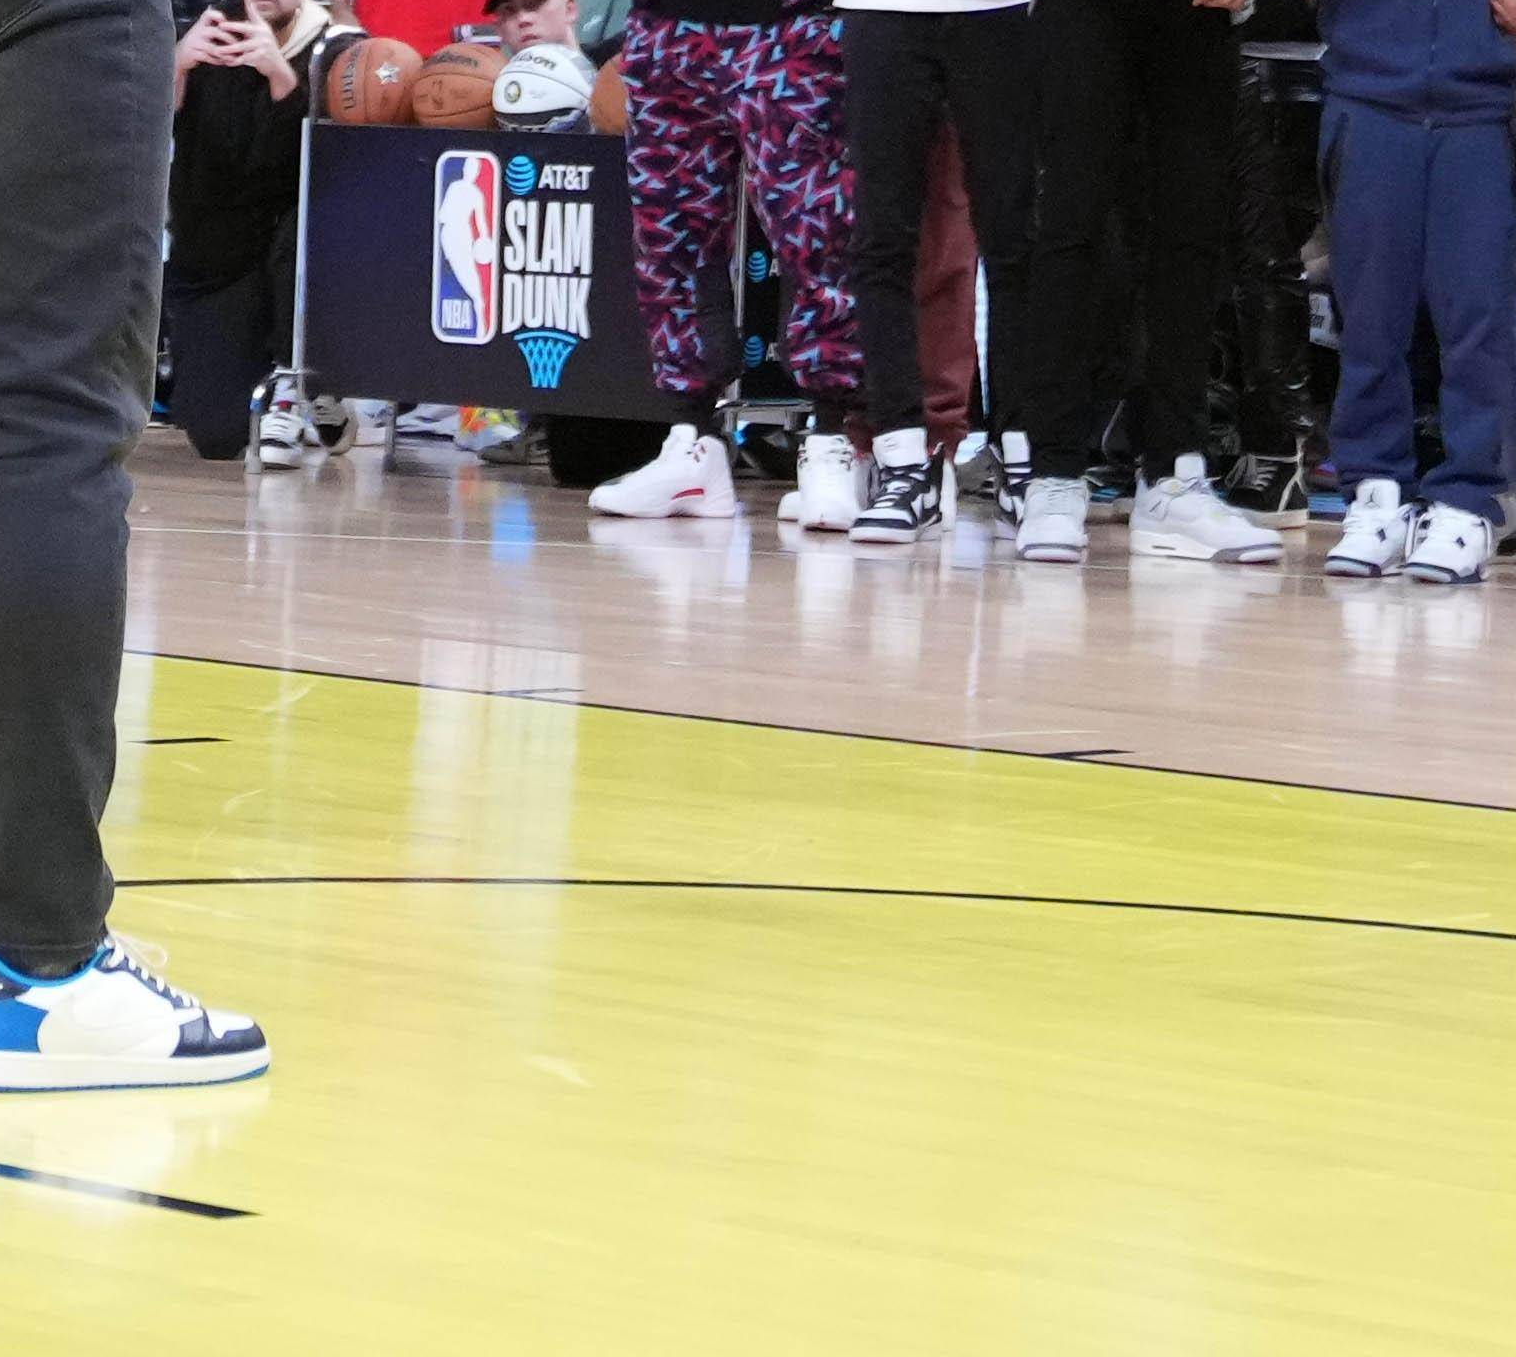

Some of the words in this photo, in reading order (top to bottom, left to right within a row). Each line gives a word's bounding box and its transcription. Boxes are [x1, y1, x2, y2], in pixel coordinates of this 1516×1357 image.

[537, 164, 594, 191] AT&T
[503, 201, 594, 276] SLAM
[441, 298, 474, 332] NBA
[502, 273, 592, 341] DUNK
